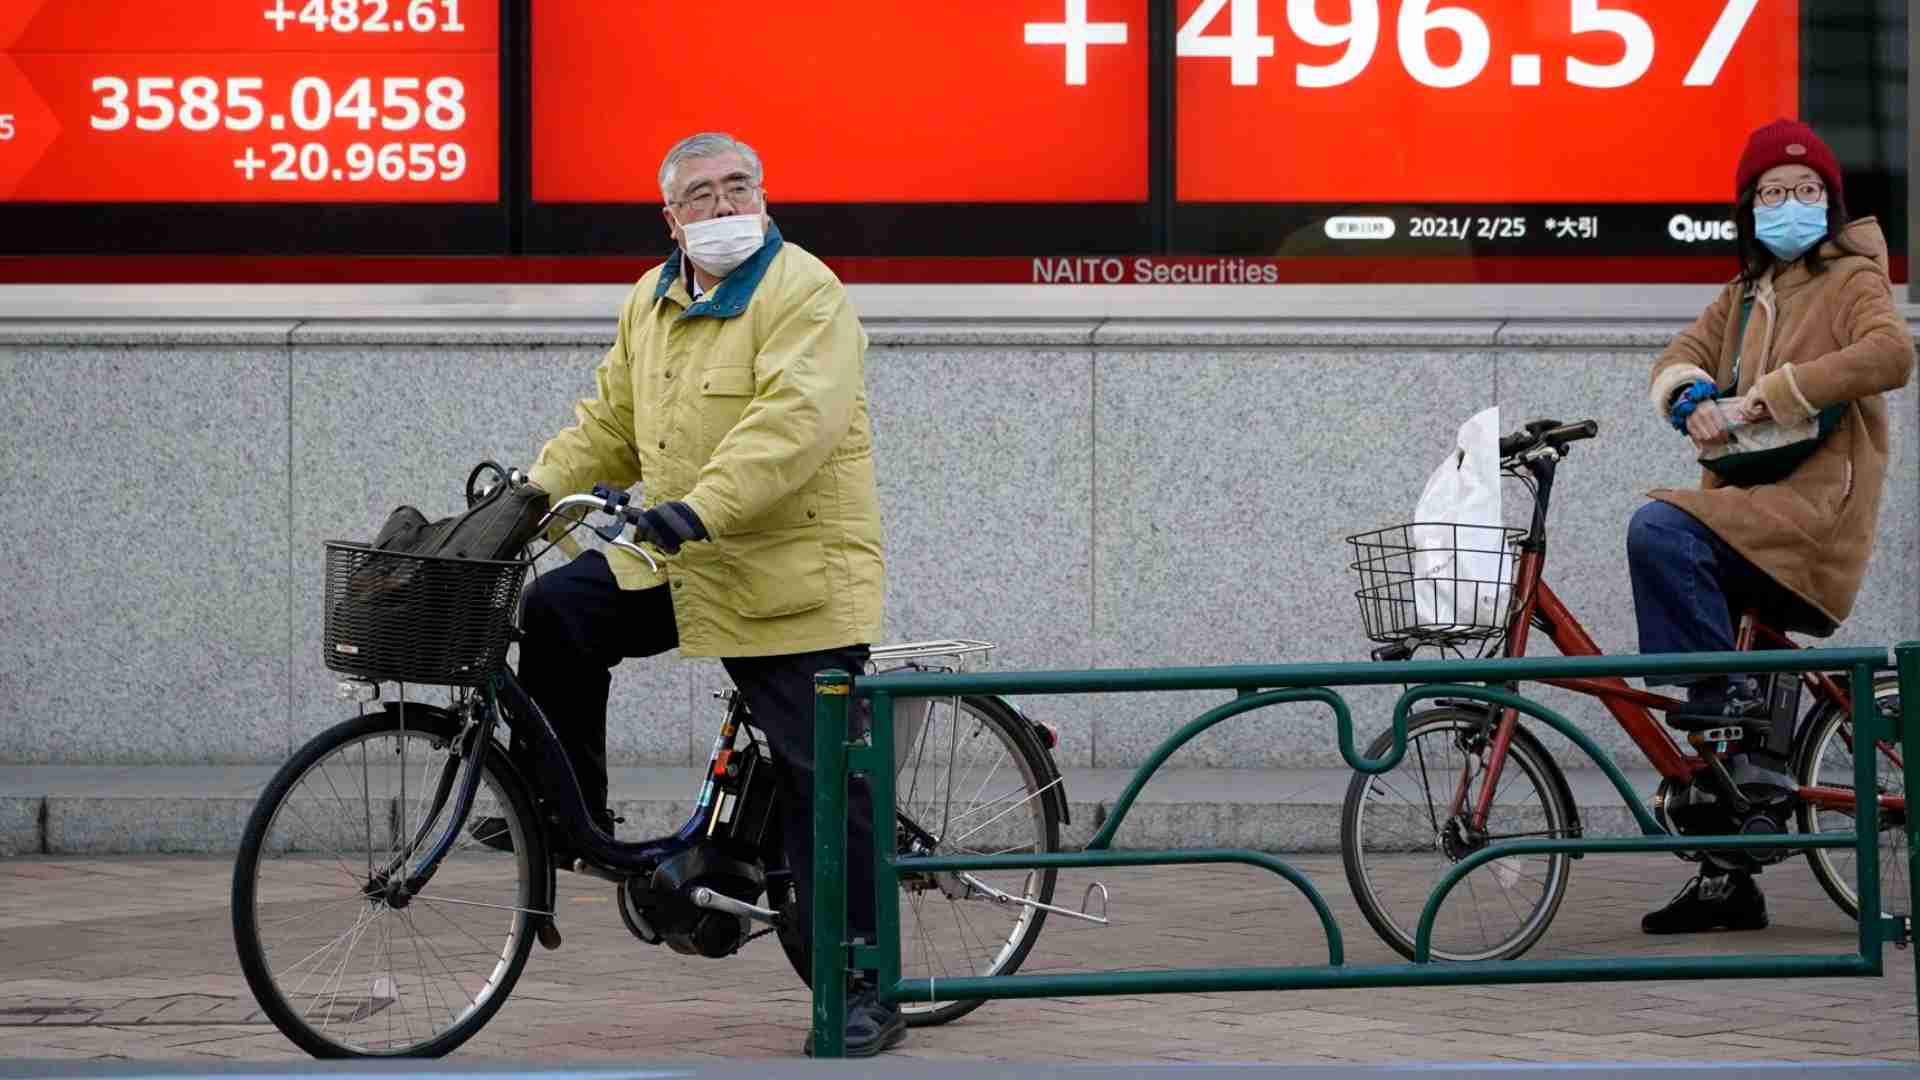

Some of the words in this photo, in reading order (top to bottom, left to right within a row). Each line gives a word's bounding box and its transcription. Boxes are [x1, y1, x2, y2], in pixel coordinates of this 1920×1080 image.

[264, 0, 465, 33] +482.61
[90, 76, 466, 132] 3585.0458
[233, 142, 467, 182] +20.9659
[1409, 216, 1470, 240] 2021/
[1477, 217, 1526, 240] 2/25
[1668, 214, 1738, 242] QUIC
[1033, 258, 1124, 283] NAITO
[1134, 258, 1279, 283] Securities
